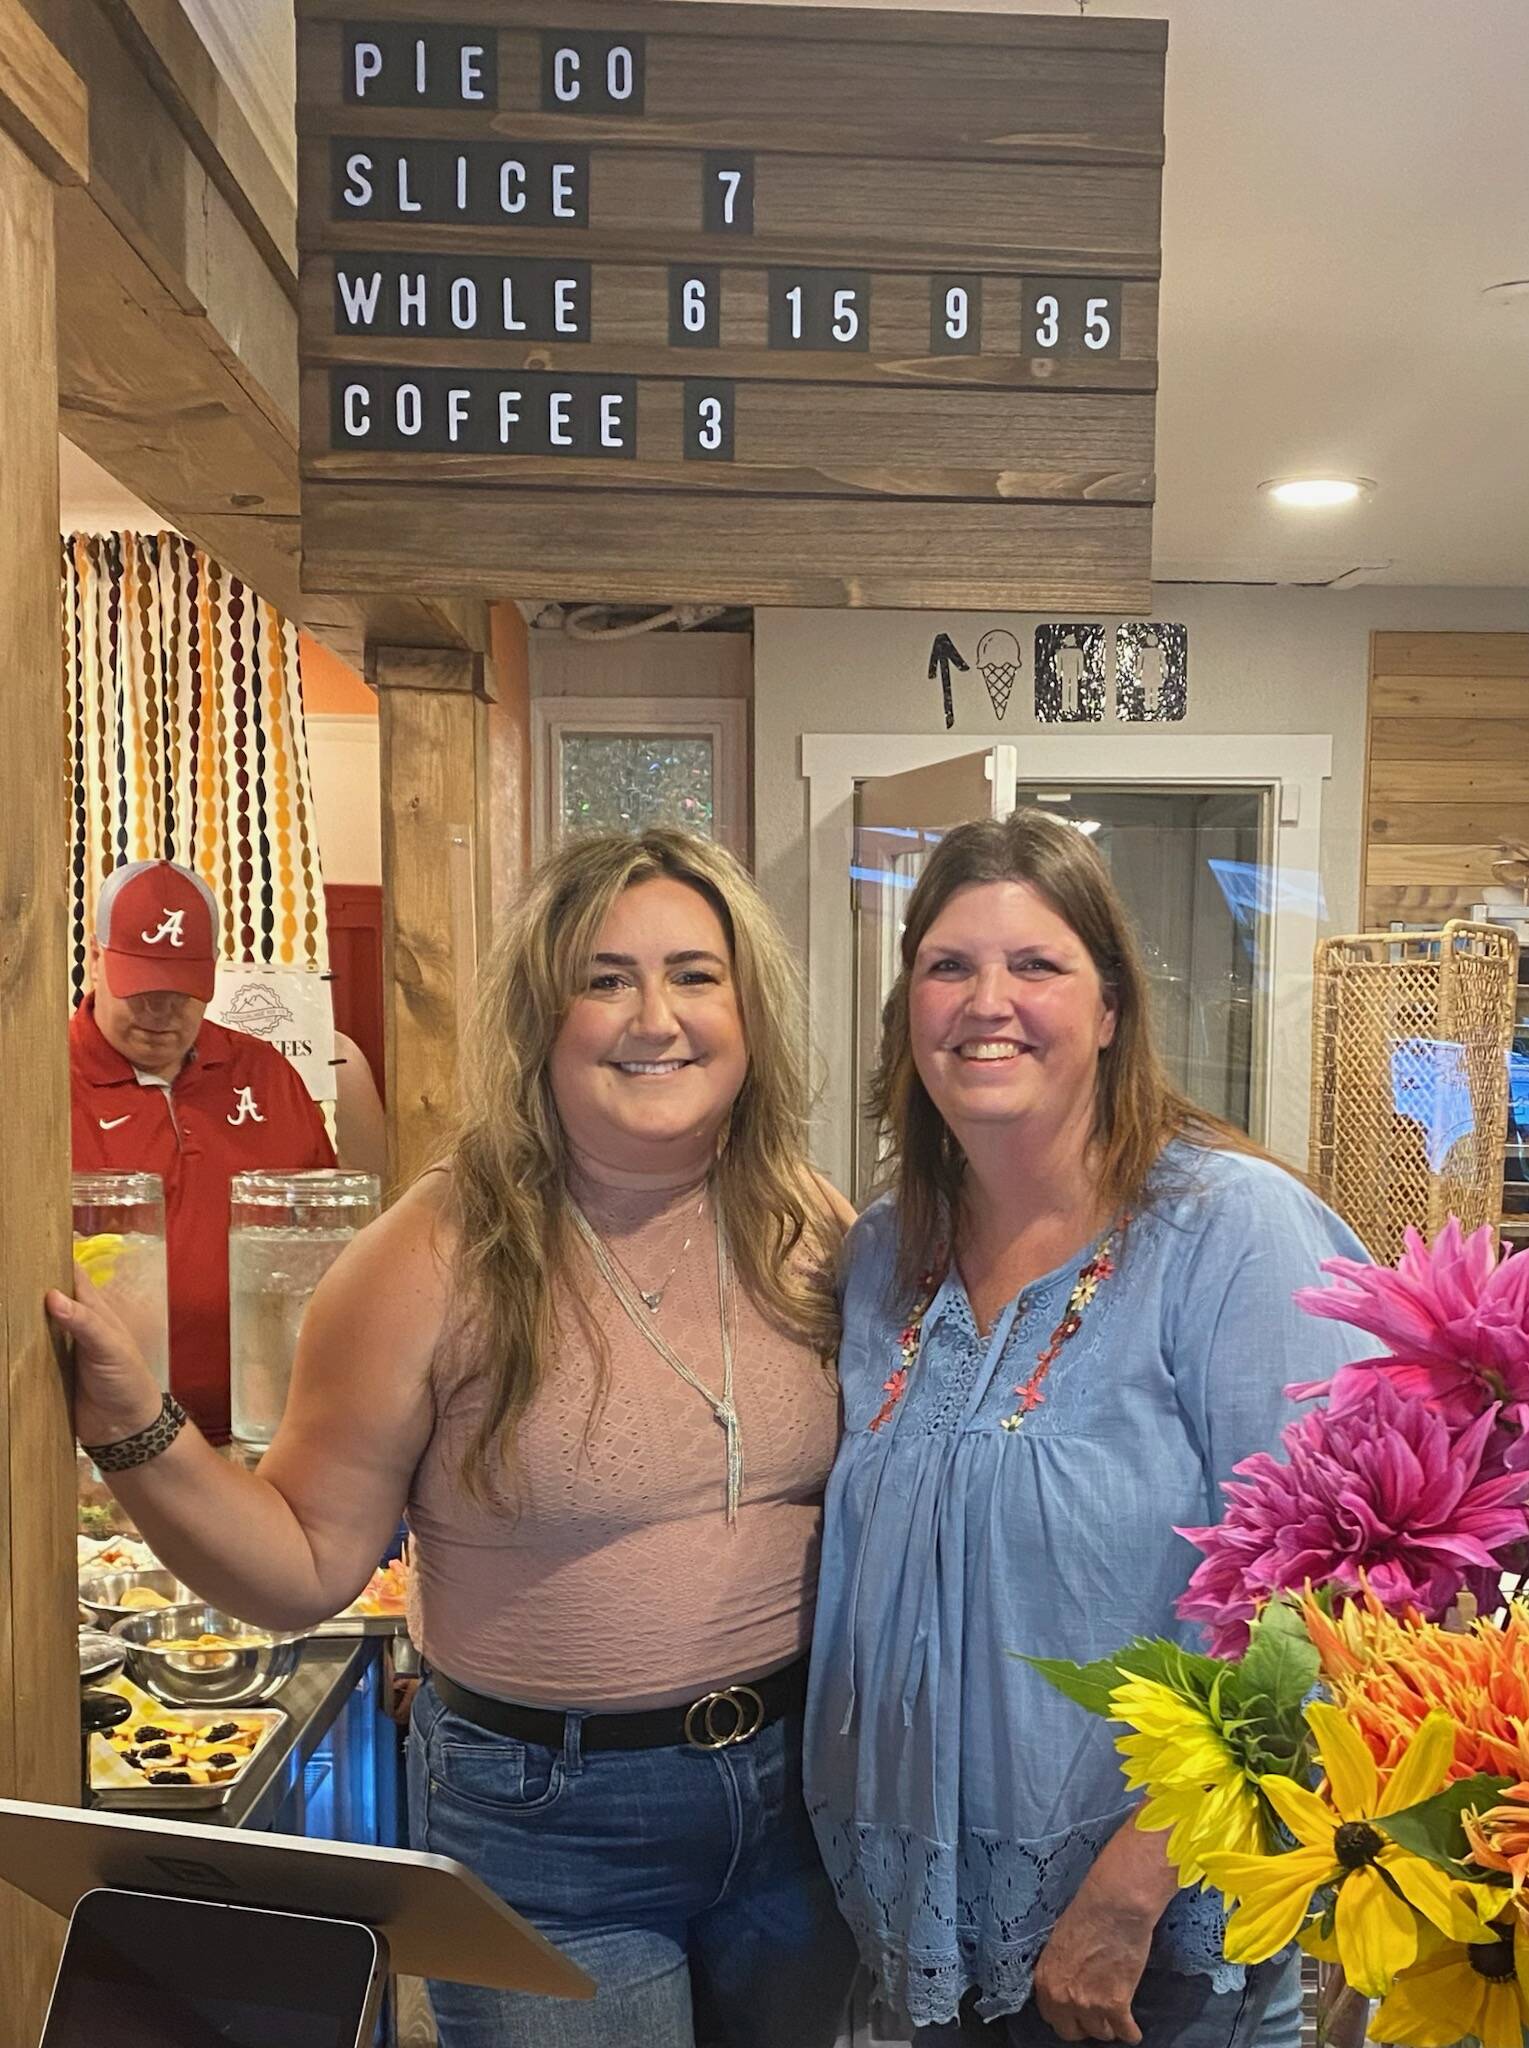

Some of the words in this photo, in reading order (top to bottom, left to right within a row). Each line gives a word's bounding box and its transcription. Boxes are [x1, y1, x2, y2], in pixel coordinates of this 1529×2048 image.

[354, 40, 485, 100] PIE
[553, 46, 634, 101] CO
[343, 154, 577, 218] SLICE
[717, 171, 742, 224] 7
[337, 272, 579, 333] WHOLE
[682, 279, 707, 332] 6
[786, 286, 860, 342] 15
[944, 287, 969, 340] 9
[1035, 295, 1112, 350] 35
[343, 383, 625, 448] COFFEE
[697, 397, 723, 450] 3
[141, 908, 185, 947] A
[227, 1086, 264, 1126] A
